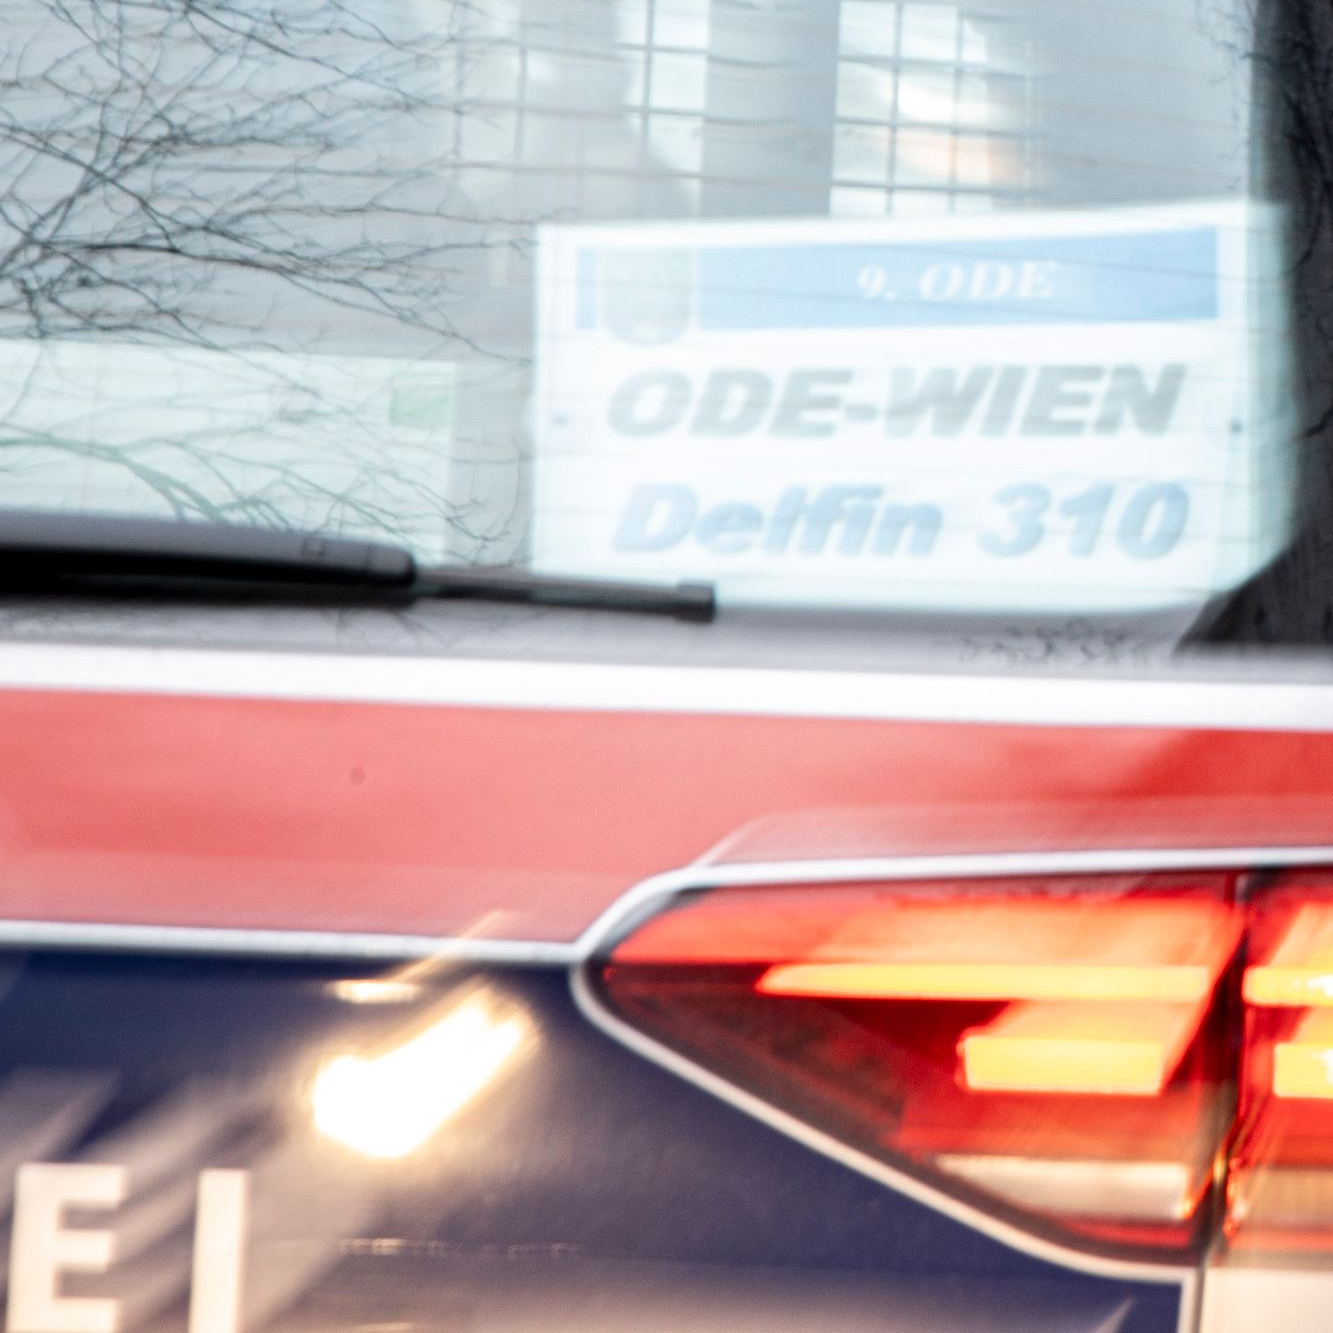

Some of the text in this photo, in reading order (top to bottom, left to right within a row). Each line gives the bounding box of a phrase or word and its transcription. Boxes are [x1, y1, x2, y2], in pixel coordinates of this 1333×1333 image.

[856, 260, 1058, 301] 9. ODE
[606, 363, 1186, 438] ODE-WIEN
[612, 481, 1191, 559] Delfin 310
